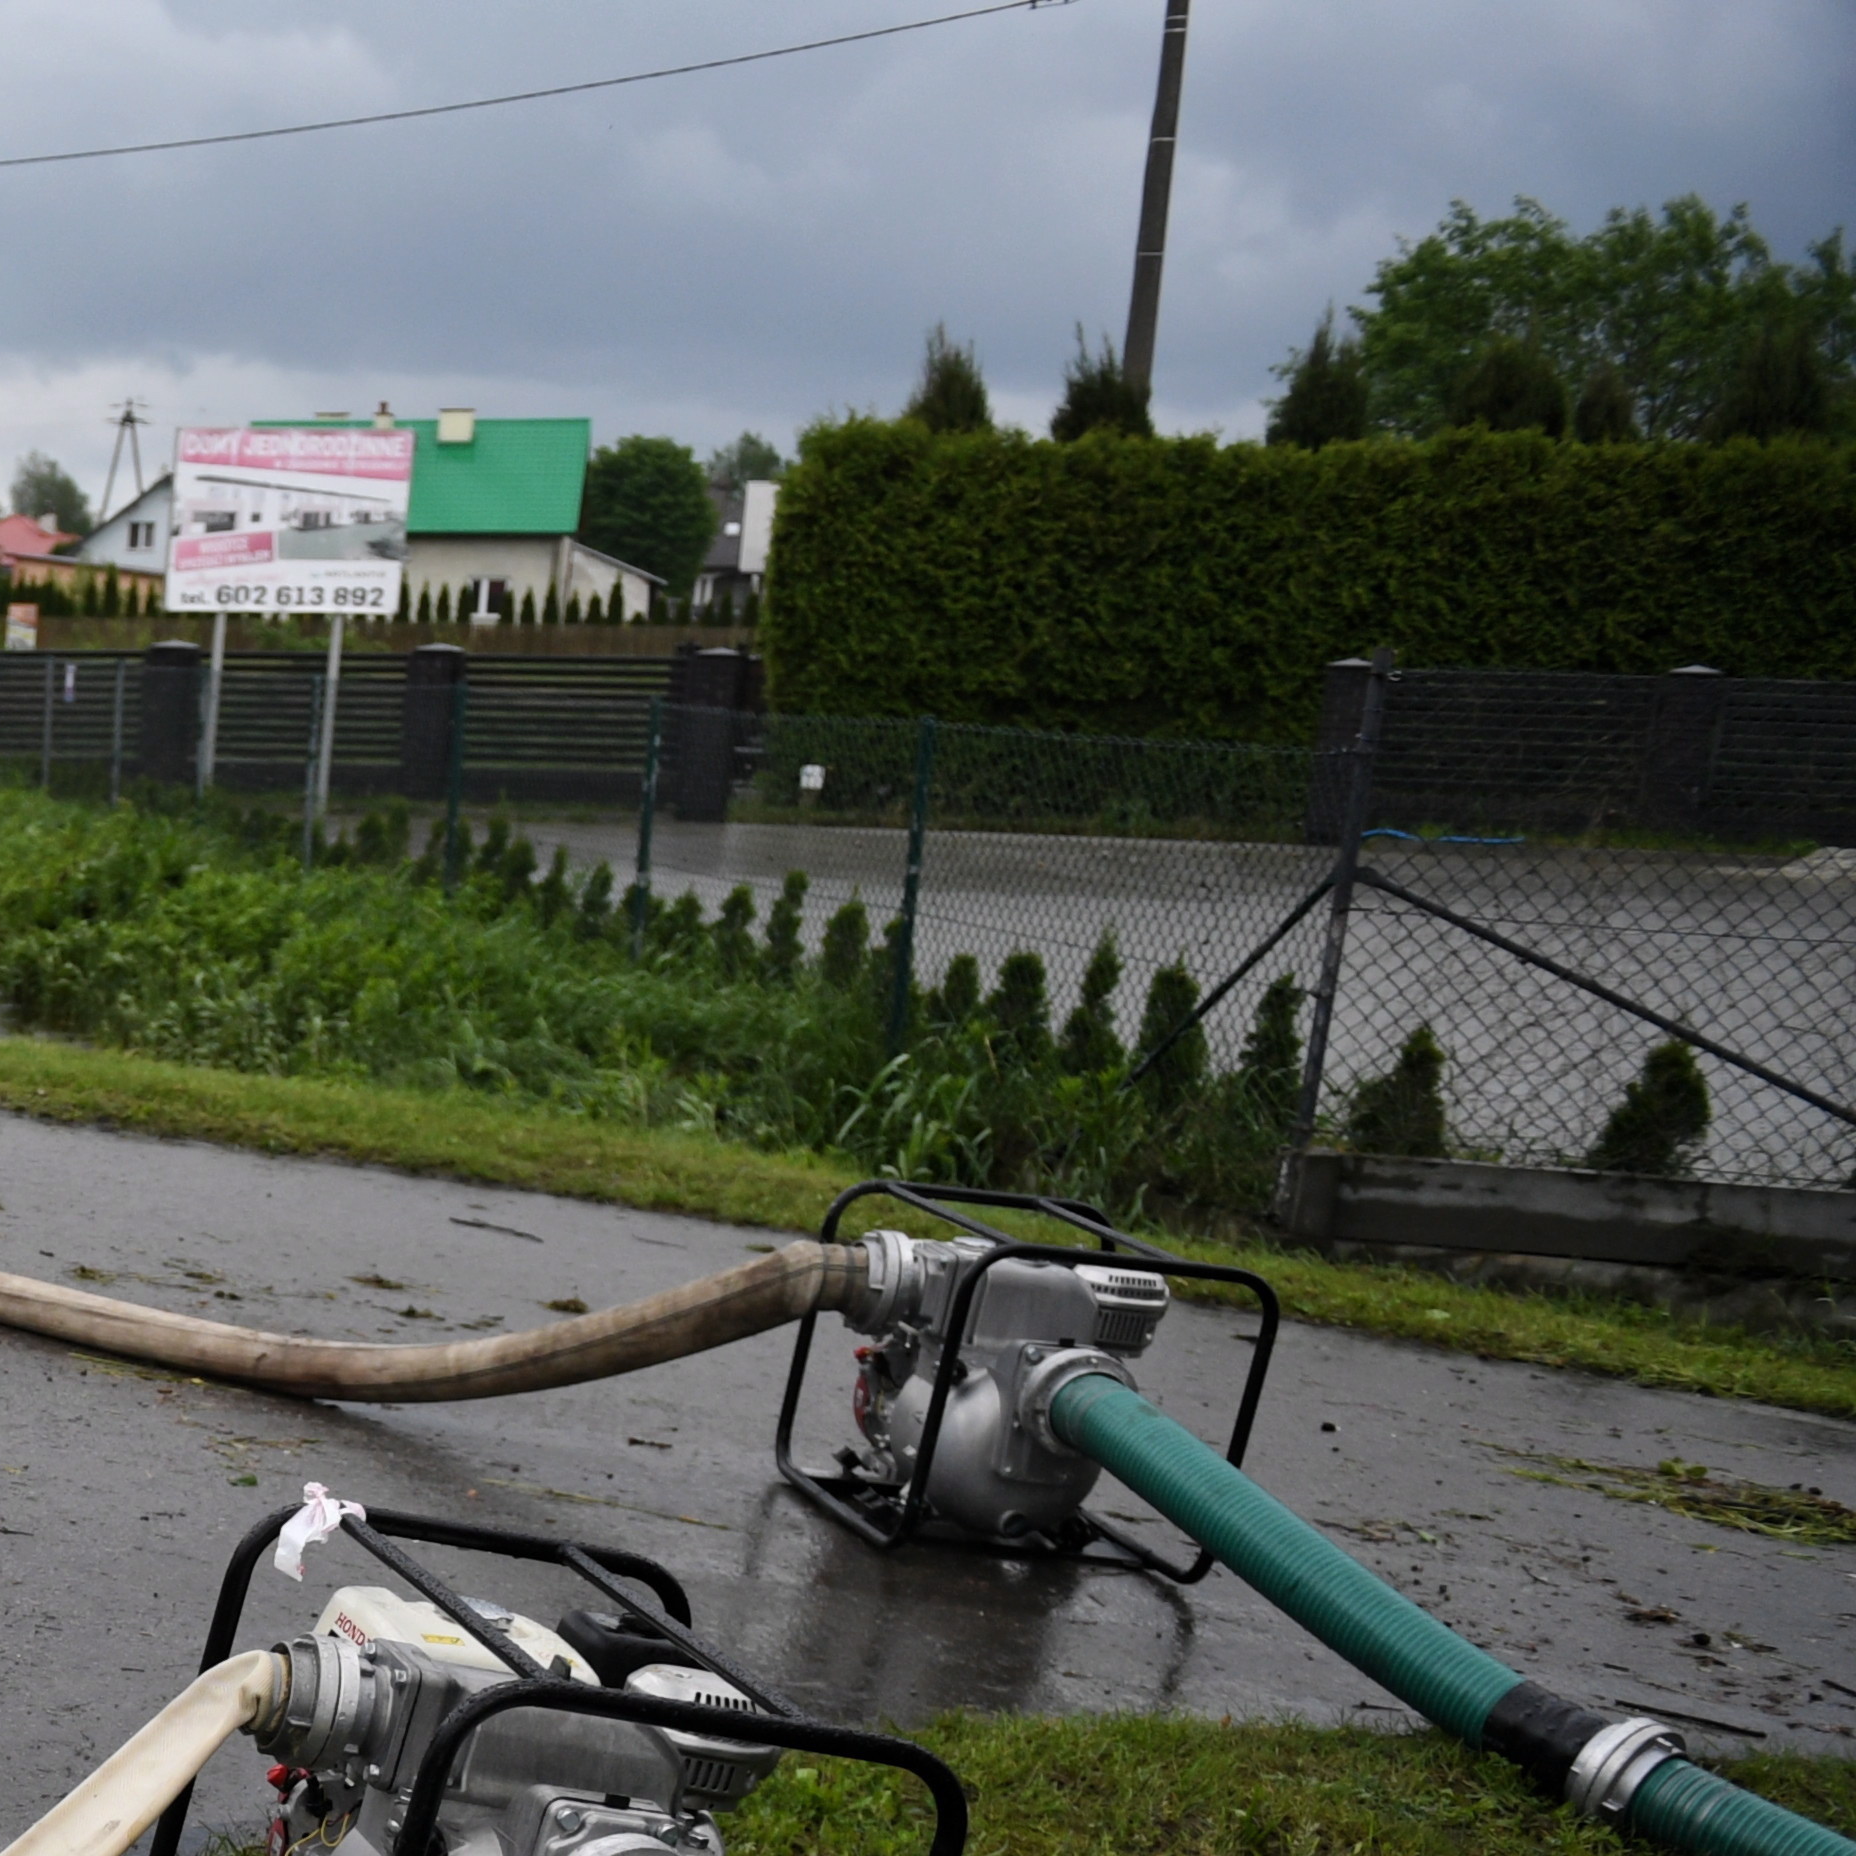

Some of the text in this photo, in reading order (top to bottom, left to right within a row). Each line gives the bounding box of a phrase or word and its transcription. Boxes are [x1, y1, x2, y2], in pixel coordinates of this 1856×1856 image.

[216, 585, 267, 605] 602
[276, 586, 324, 606] 613
[333, 587, 385, 607] 892
[334, 1611, 372, 1647] HOND
